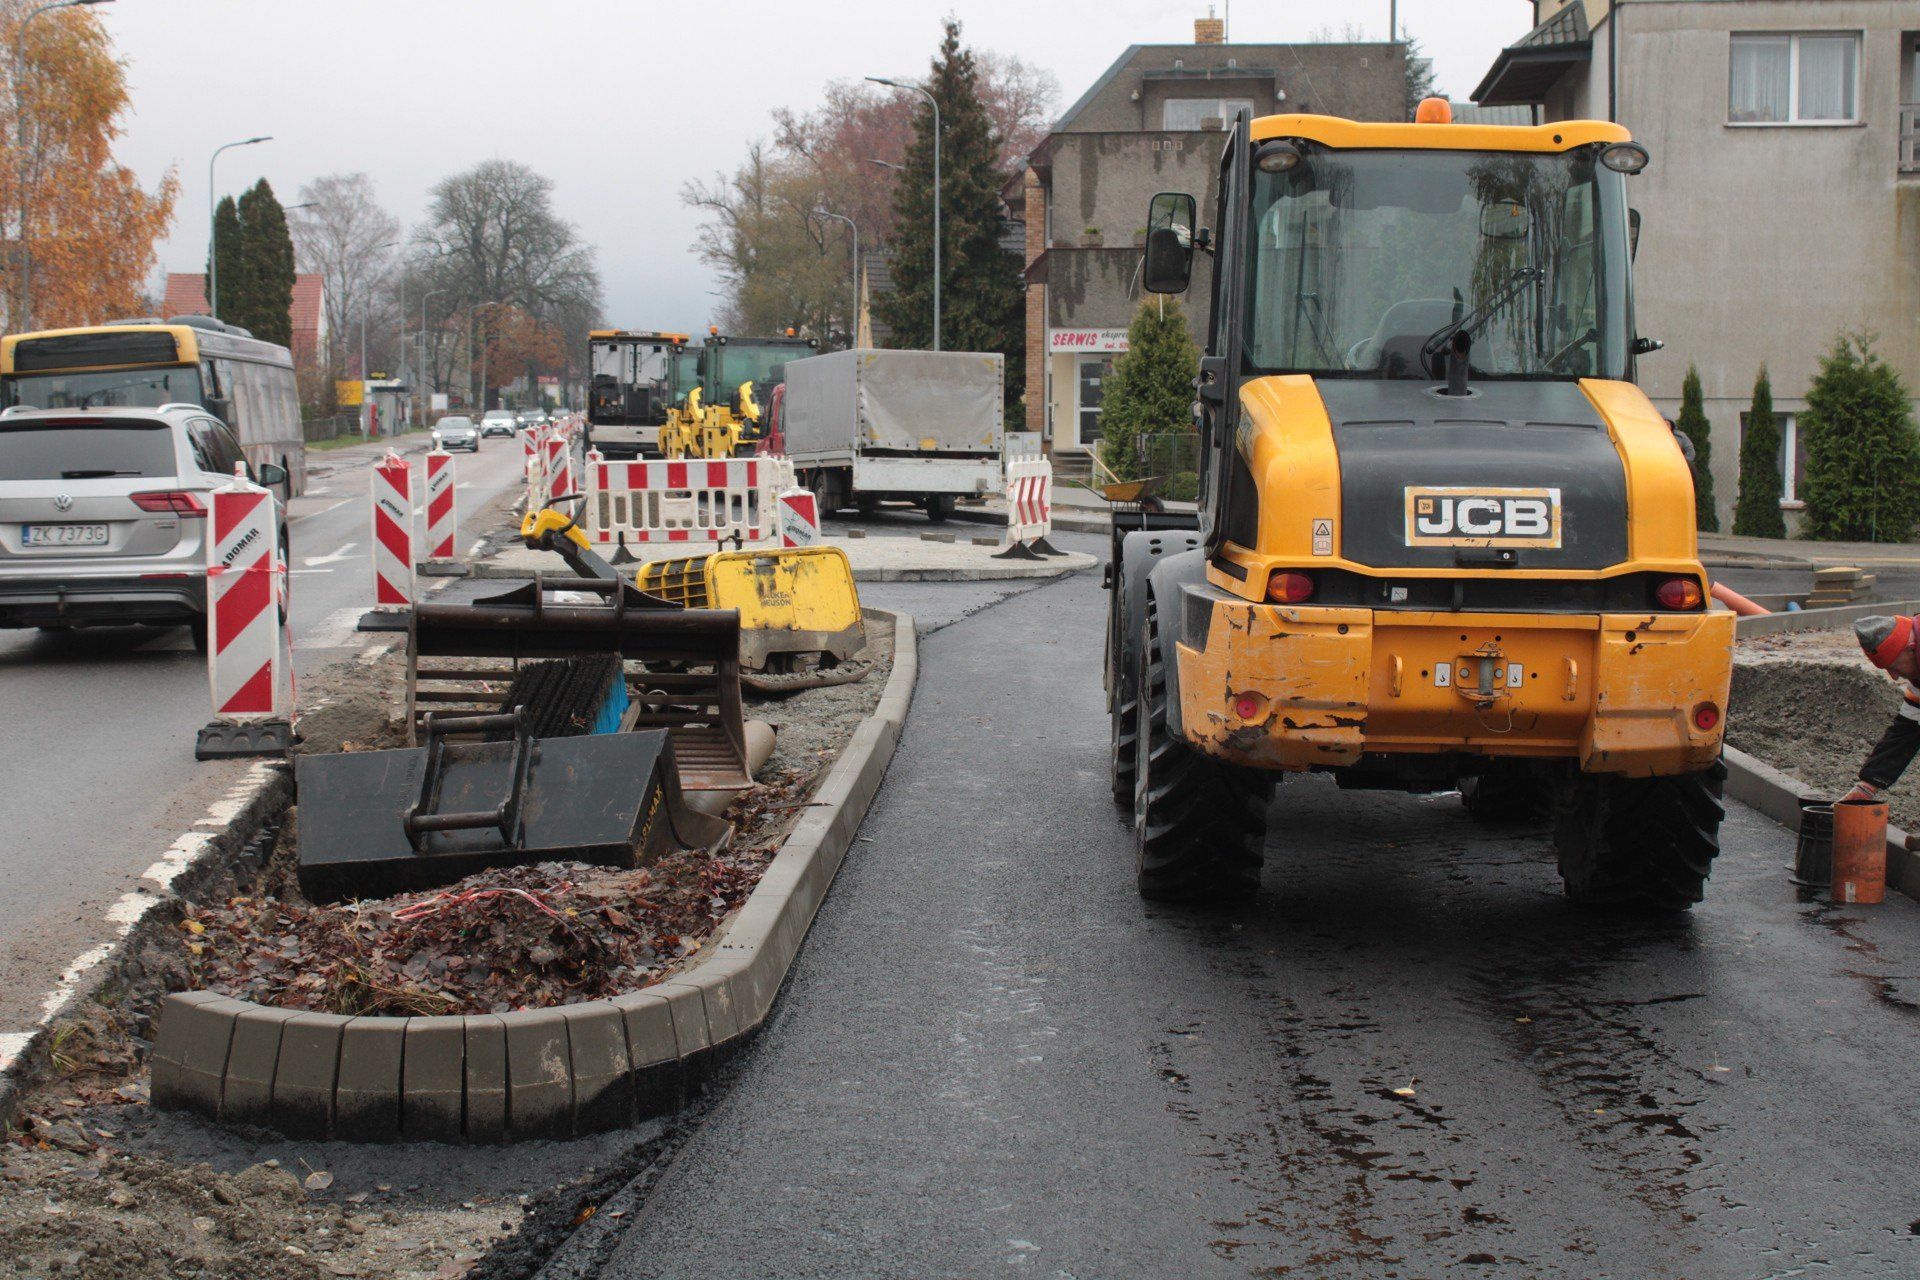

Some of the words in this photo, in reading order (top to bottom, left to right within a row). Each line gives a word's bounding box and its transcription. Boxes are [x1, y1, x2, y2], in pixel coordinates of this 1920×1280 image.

[1053, 333, 1098, 346] SERWIS
[1418, 499, 1549, 535] JCB
[32, 527, 51, 542] ZK
[57, 526, 104, 541] 7373G
